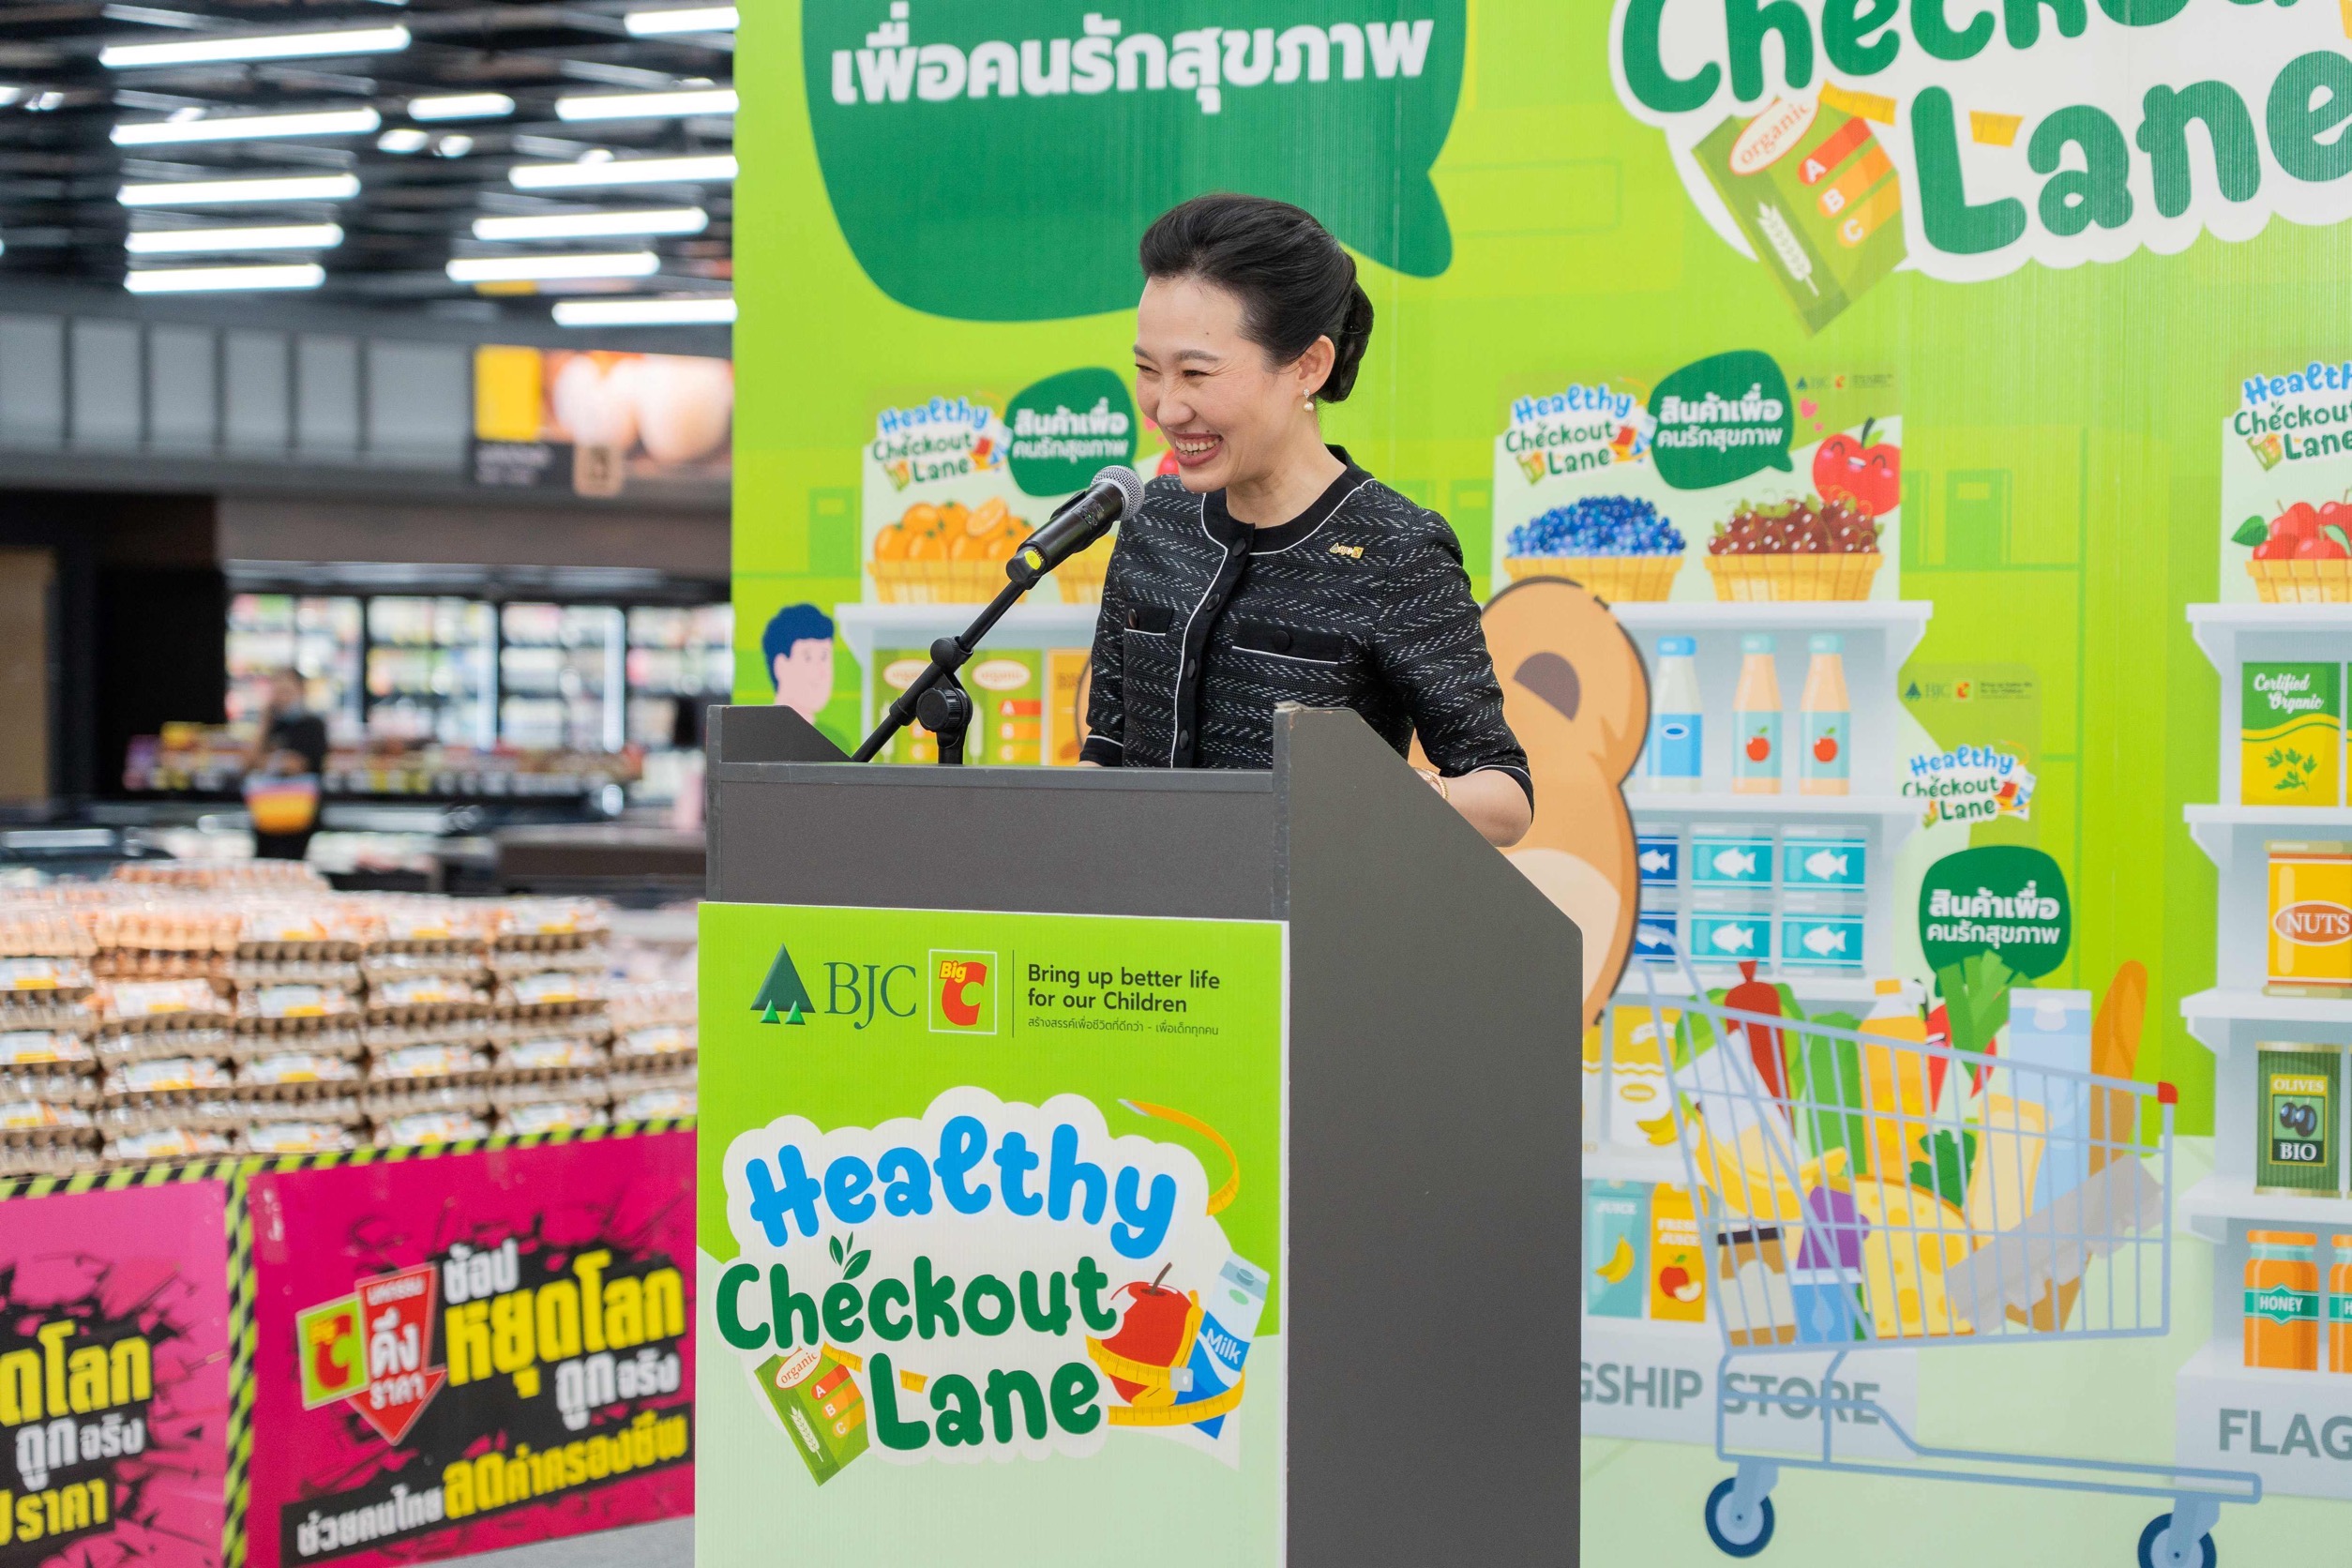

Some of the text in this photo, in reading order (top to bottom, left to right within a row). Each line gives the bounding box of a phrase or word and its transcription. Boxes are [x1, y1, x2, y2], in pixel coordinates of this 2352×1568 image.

[831, 1, 1434, 113] เพื่อคนรักสุขภาพ
[1622, 0, 2300, 113] Chec
[1909, 51, 2352, 254] Lane
[1805, 158, 1827, 183] A
[1822, 188, 1845, 214] B
[1844, 219, 1864, 243] C
[881, 397, 989, 432] Healthy
[1515, 385, 1631, 423] Healthy
[1659, 383, 1784, 424] สินค้าเพื่อ
[2234, 400, 2352, 436] Checkou
[873, 432, 973, 460] Checkout
[1505, 421, 1615, 452] Checkout
[1657, 425, 1784, 453] คนรักสุขภาพ
[912, 458, 970, 483] Lane
[1548, 448, 1610, 475] Lane
[2254, 673, 2311, 695] Certified
[2268, 691, 2325, 714] Organic
[1910, 746, 2013, 776] Healthy
[1940, 799, 1996, 821] Lane
[1929, 880, 2060, 920] สินค้าเพื่อ
[1926, 919, 2060, 949] คนรักสุขภาพ
[2285, 912, 2350, 935] NUTS
[939, 960, 967, 984] Big
[1028, 963, 1220, 989] Bring up better life
[822, 961, 916, 1030] BJC
[942, 961, 988, 1026] C
[1028, 988, 1187, 1013] for our Children
[2273, 1078, 2325, 1093] OLIVES
[2280, 1142, 2317, 1161] BIO
[746, 1115, 1177, 1259] Healthy
[716, 1255, 1117, 1350] Checkout
[2259, 1295, 2304, 1313] HONEY
[445, 1248, 686, 1399] หยุดโลก
[1206, 1328, 1242, 1364] Milk
[780, 1351, 818, 1384] organic
[815, 1384, 827, 1399] A
[869, 1352, 1102, 1452] Lane
[1581, 1362, 1880, 1425] SHIP STORE
[825, 1404, 837, 1417] B
[836, 1422, 847, 1435] C
